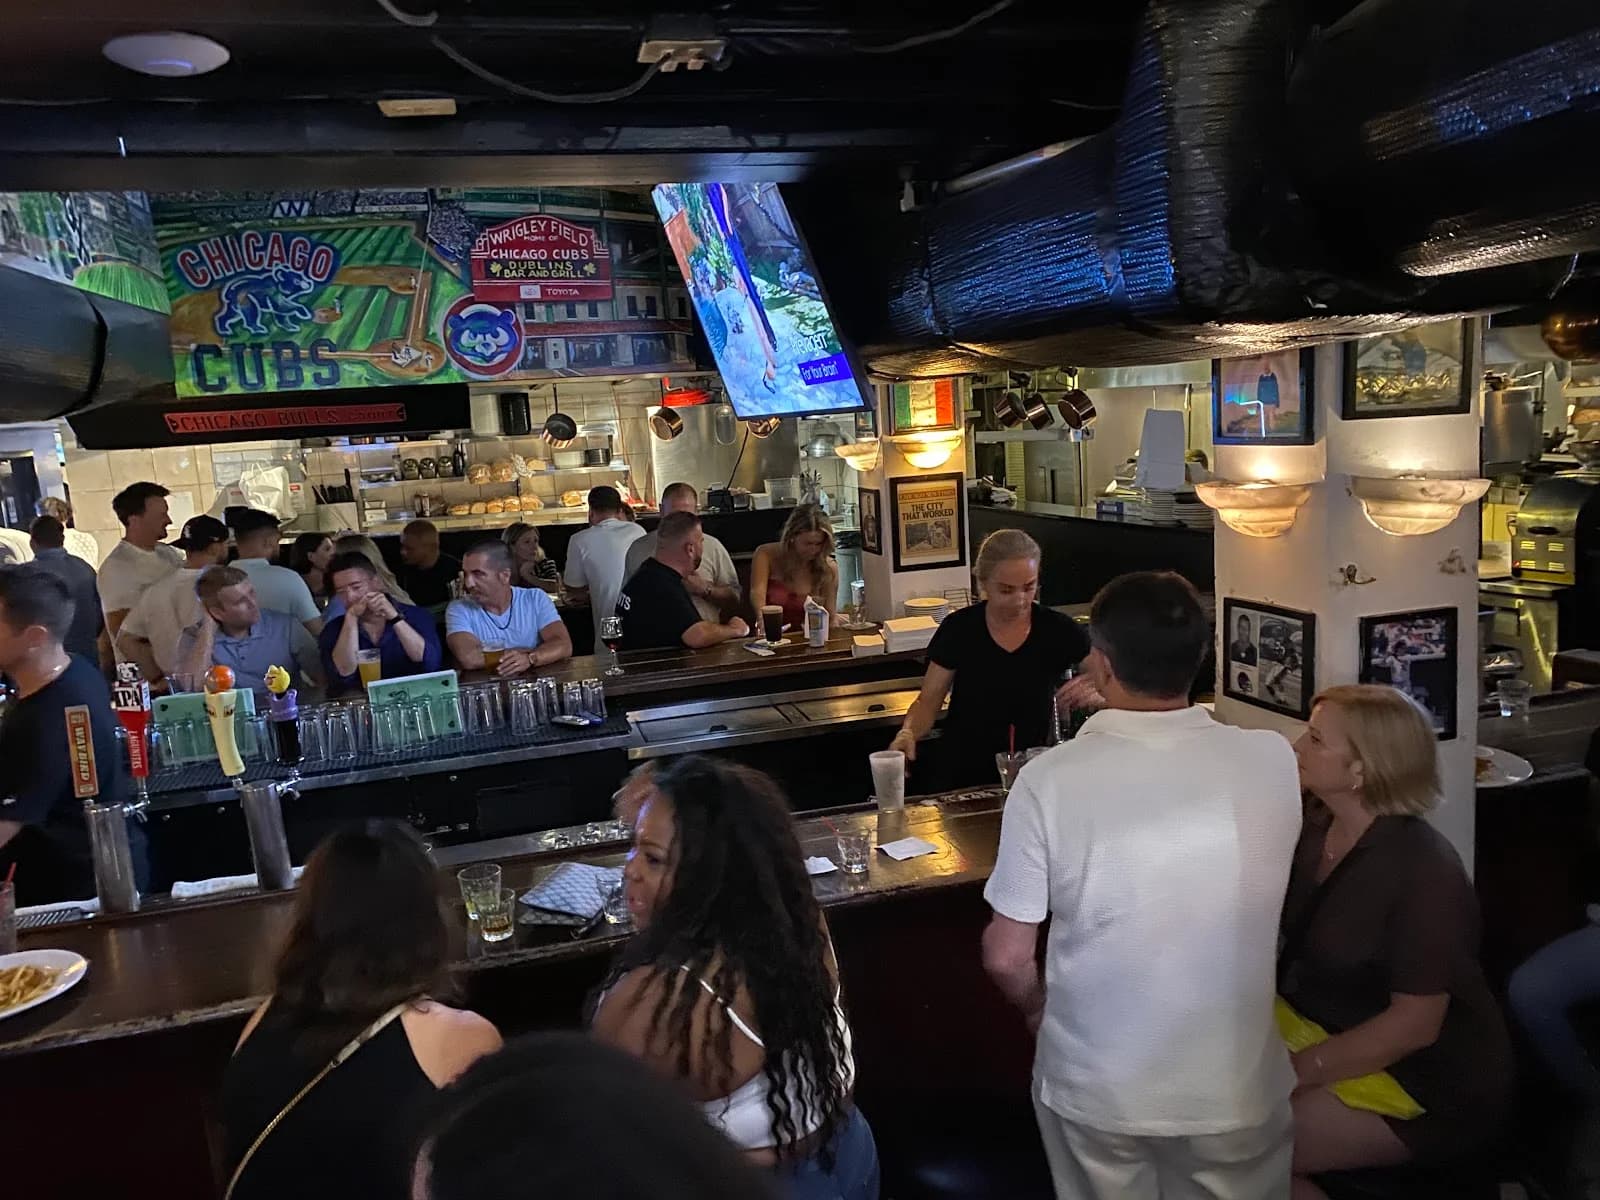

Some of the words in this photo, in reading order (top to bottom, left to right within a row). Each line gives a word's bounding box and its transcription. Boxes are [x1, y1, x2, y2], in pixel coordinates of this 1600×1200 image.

[490, 220, 547, 245] WRIGLEY
[551, 220, 588, 247] FIELD
[177, 231, 333, 288] CHICAGO
[491, 249, 547, 259] CHICAGO
[552, 249, 589, 260] CUBS
[509, 261, 573, 270] DUBLINS
[504, 269, 526, 278] BAR
[528, 269, 550, 278] AND
[551, 269, 585, 278] GRILL
[545, 288, 580, 296] TOYOTA
[193, 338, 341, 393] CUBS
[180, 412, 267, 432] CHICAGO
[278, 410, 338, 426] BULLS
[926, 502, 944, 510] CITY
[902, 512, 919, 520] THAT
[922, 509, 953, 518] WORKED
[115, 688, 141, 708] IPA
